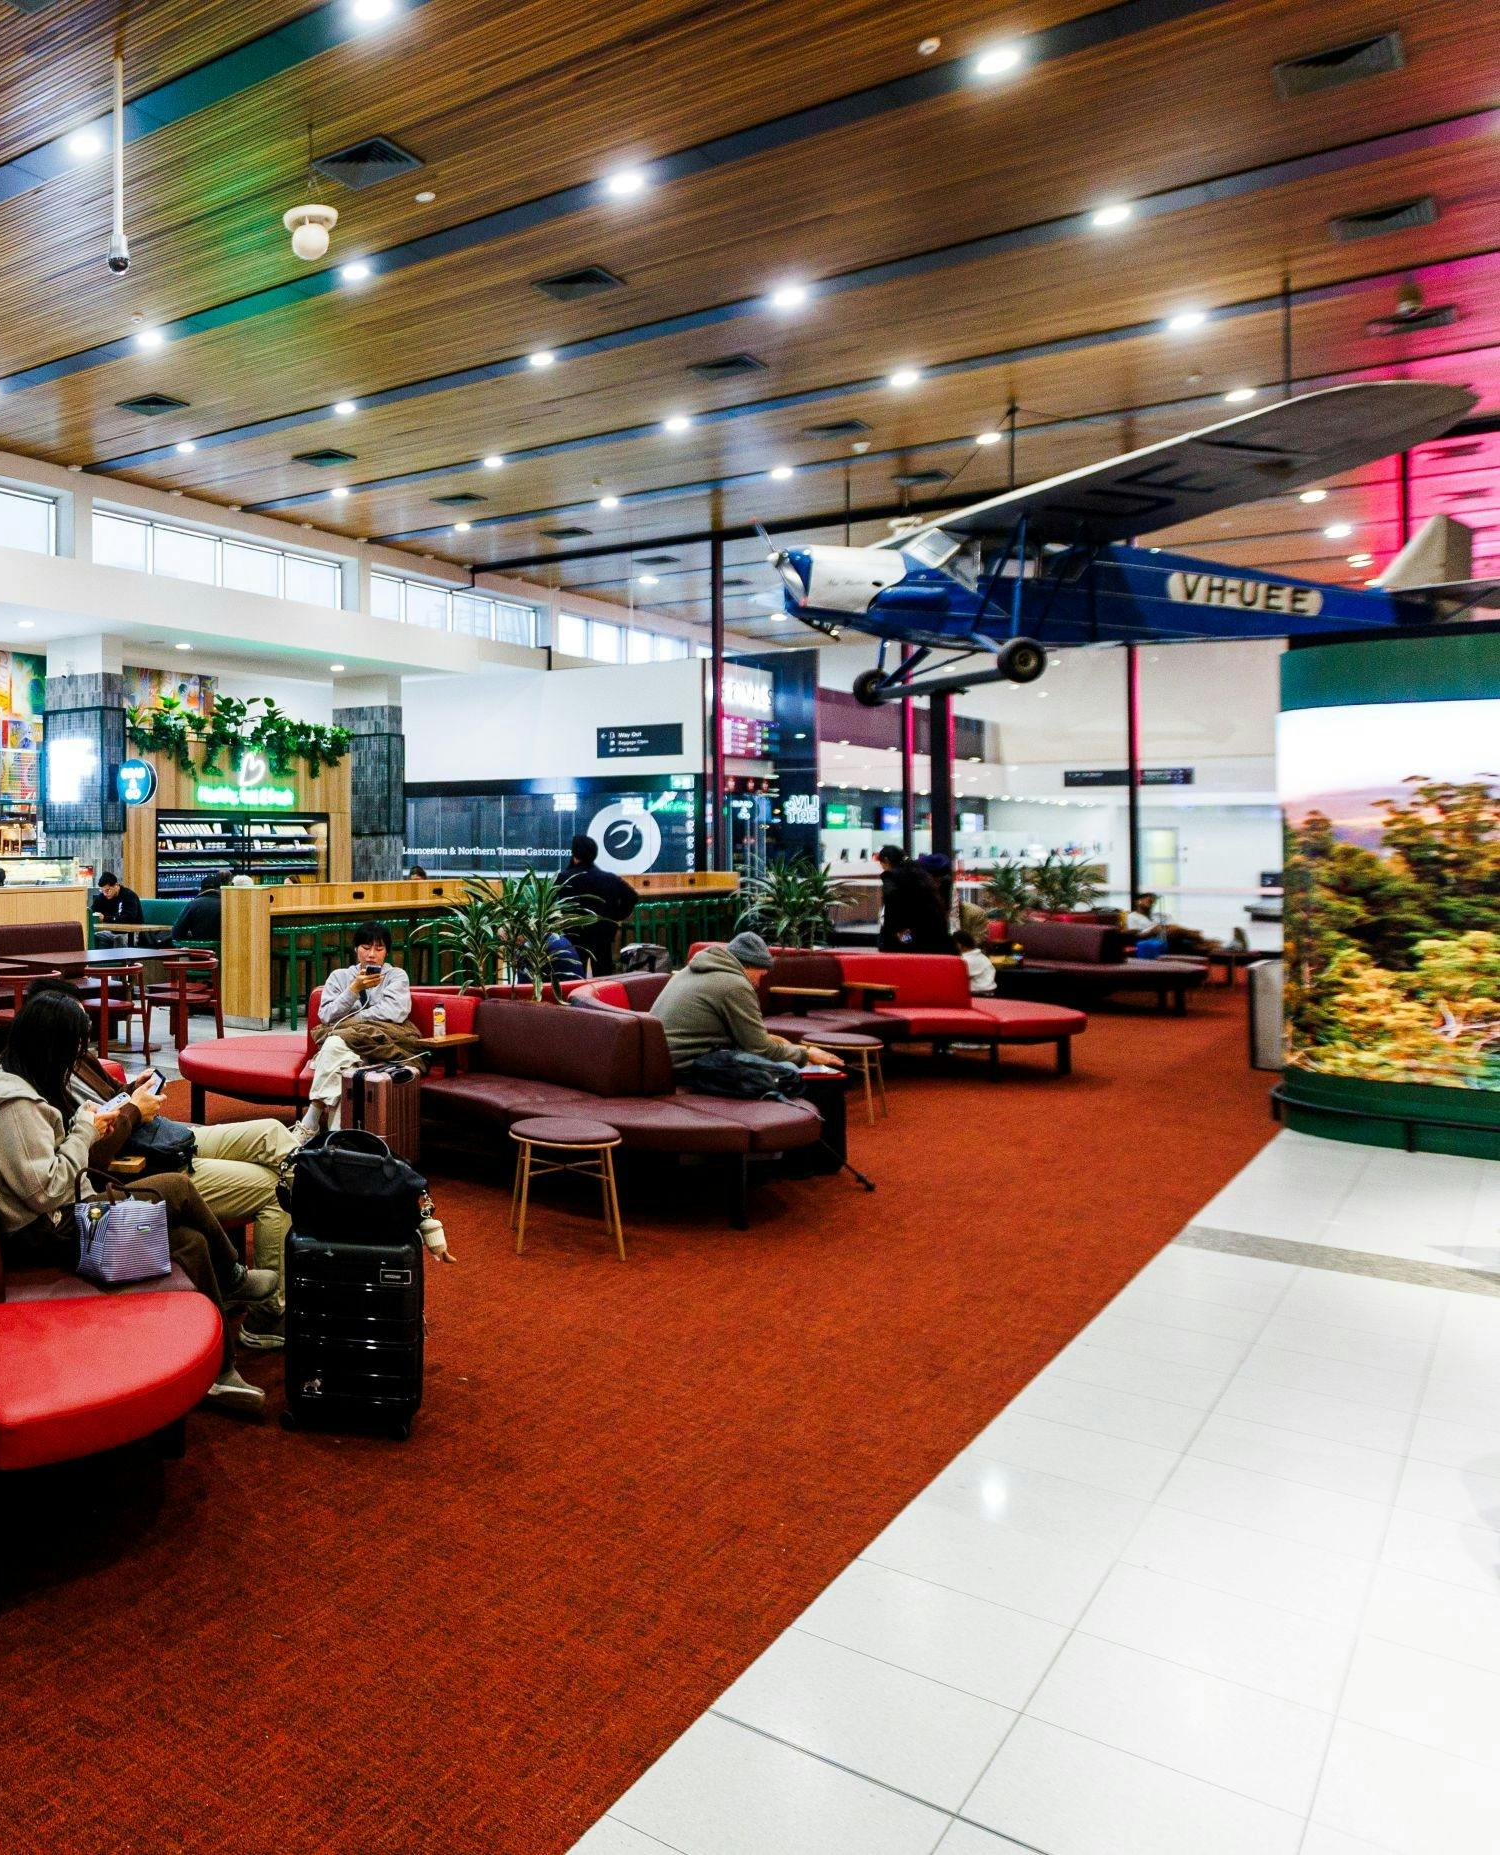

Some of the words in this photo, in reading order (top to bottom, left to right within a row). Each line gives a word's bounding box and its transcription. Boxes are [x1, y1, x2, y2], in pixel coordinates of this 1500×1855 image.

[1183, 572, 1311, 613] VH-UEE
[402, 846, 448, 856] Launceston
[449, 847, 456, 856] &
[458, 846, 496, 856] Northern
